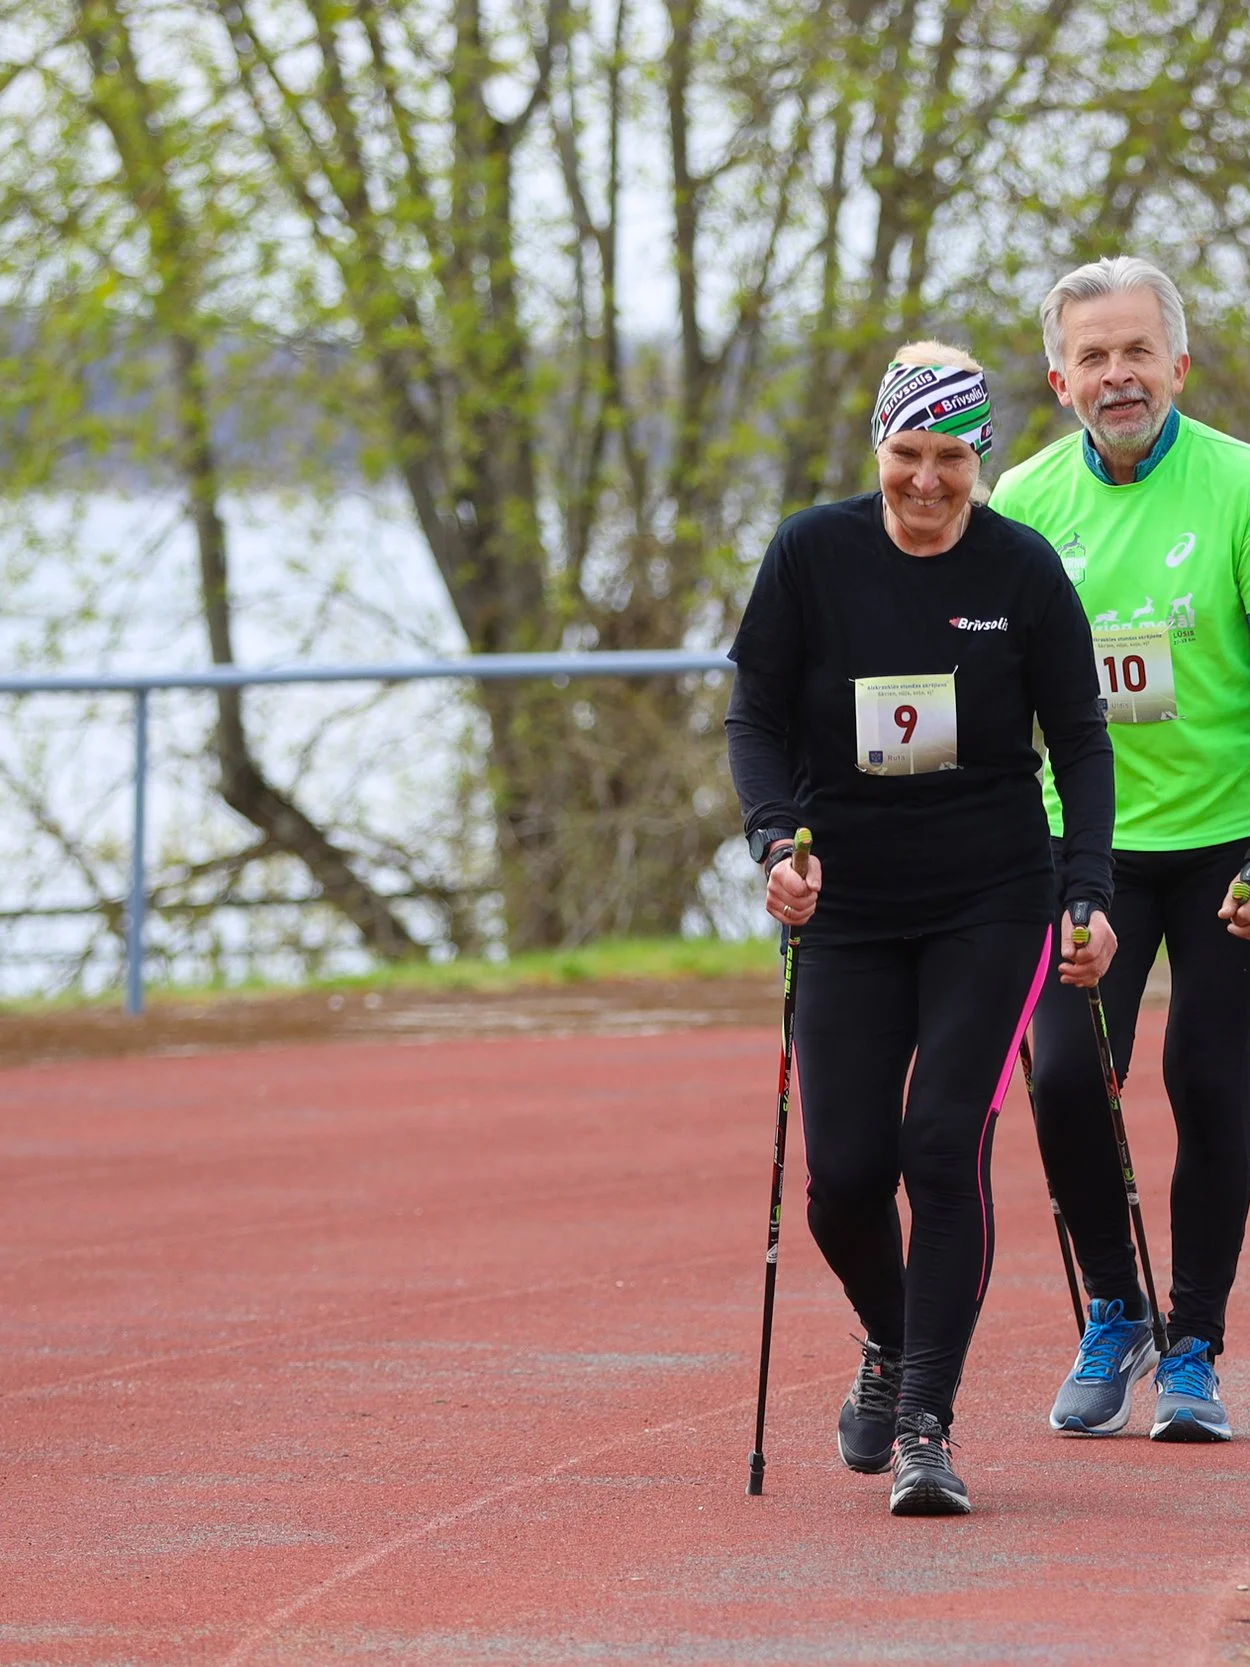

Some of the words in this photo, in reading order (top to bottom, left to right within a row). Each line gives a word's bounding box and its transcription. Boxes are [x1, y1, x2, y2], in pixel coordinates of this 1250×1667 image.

[941, 386, 983, 412] Brīvsolis
[1103, 654, 1147, 693] 10
[894, 704, 918, 745] 9
